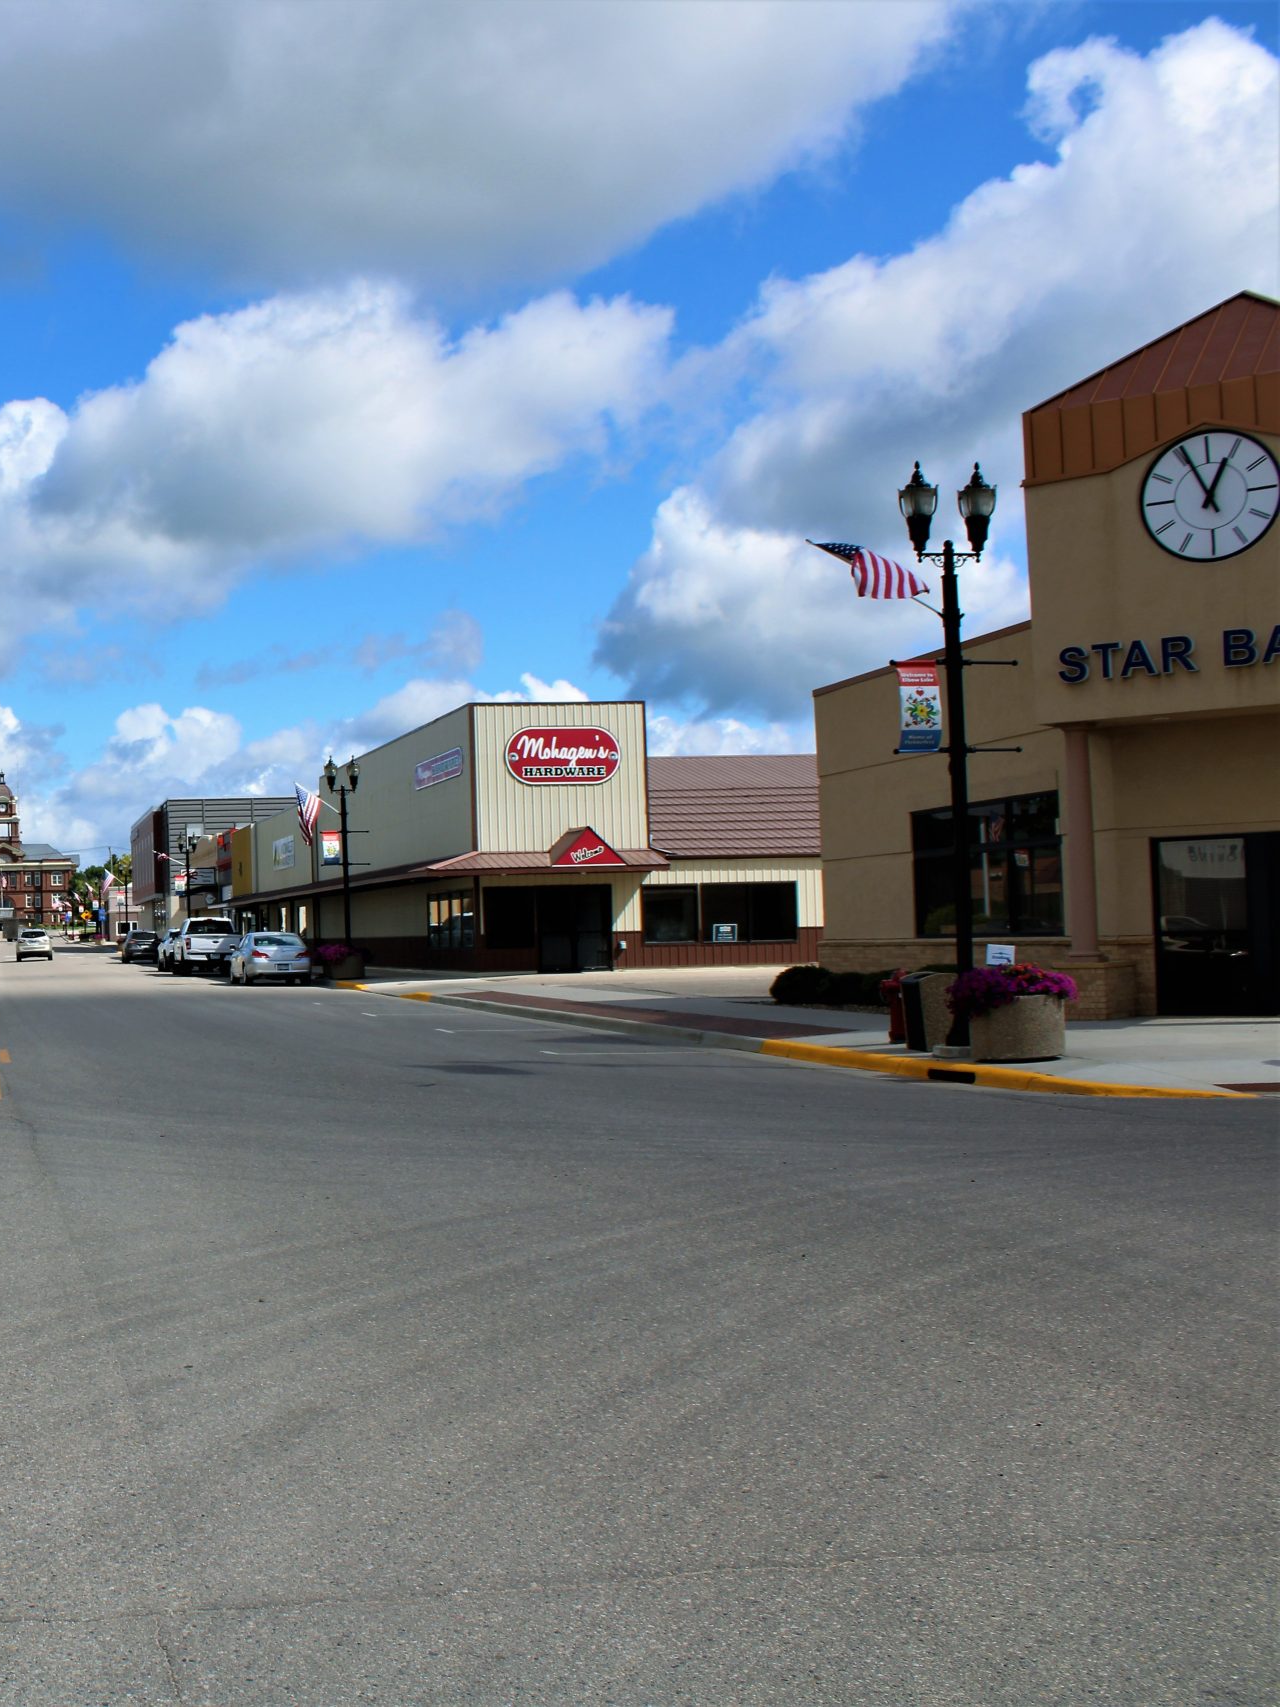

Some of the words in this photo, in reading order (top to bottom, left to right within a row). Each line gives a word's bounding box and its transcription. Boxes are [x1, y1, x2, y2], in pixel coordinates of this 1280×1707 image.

[1058, 636, 1199, 684] STAR
[517, 735, 608, 767] Mohagen's
[523, 767, 605, 777] HARDWARE
[570, 846, 604, 863] Welcome
